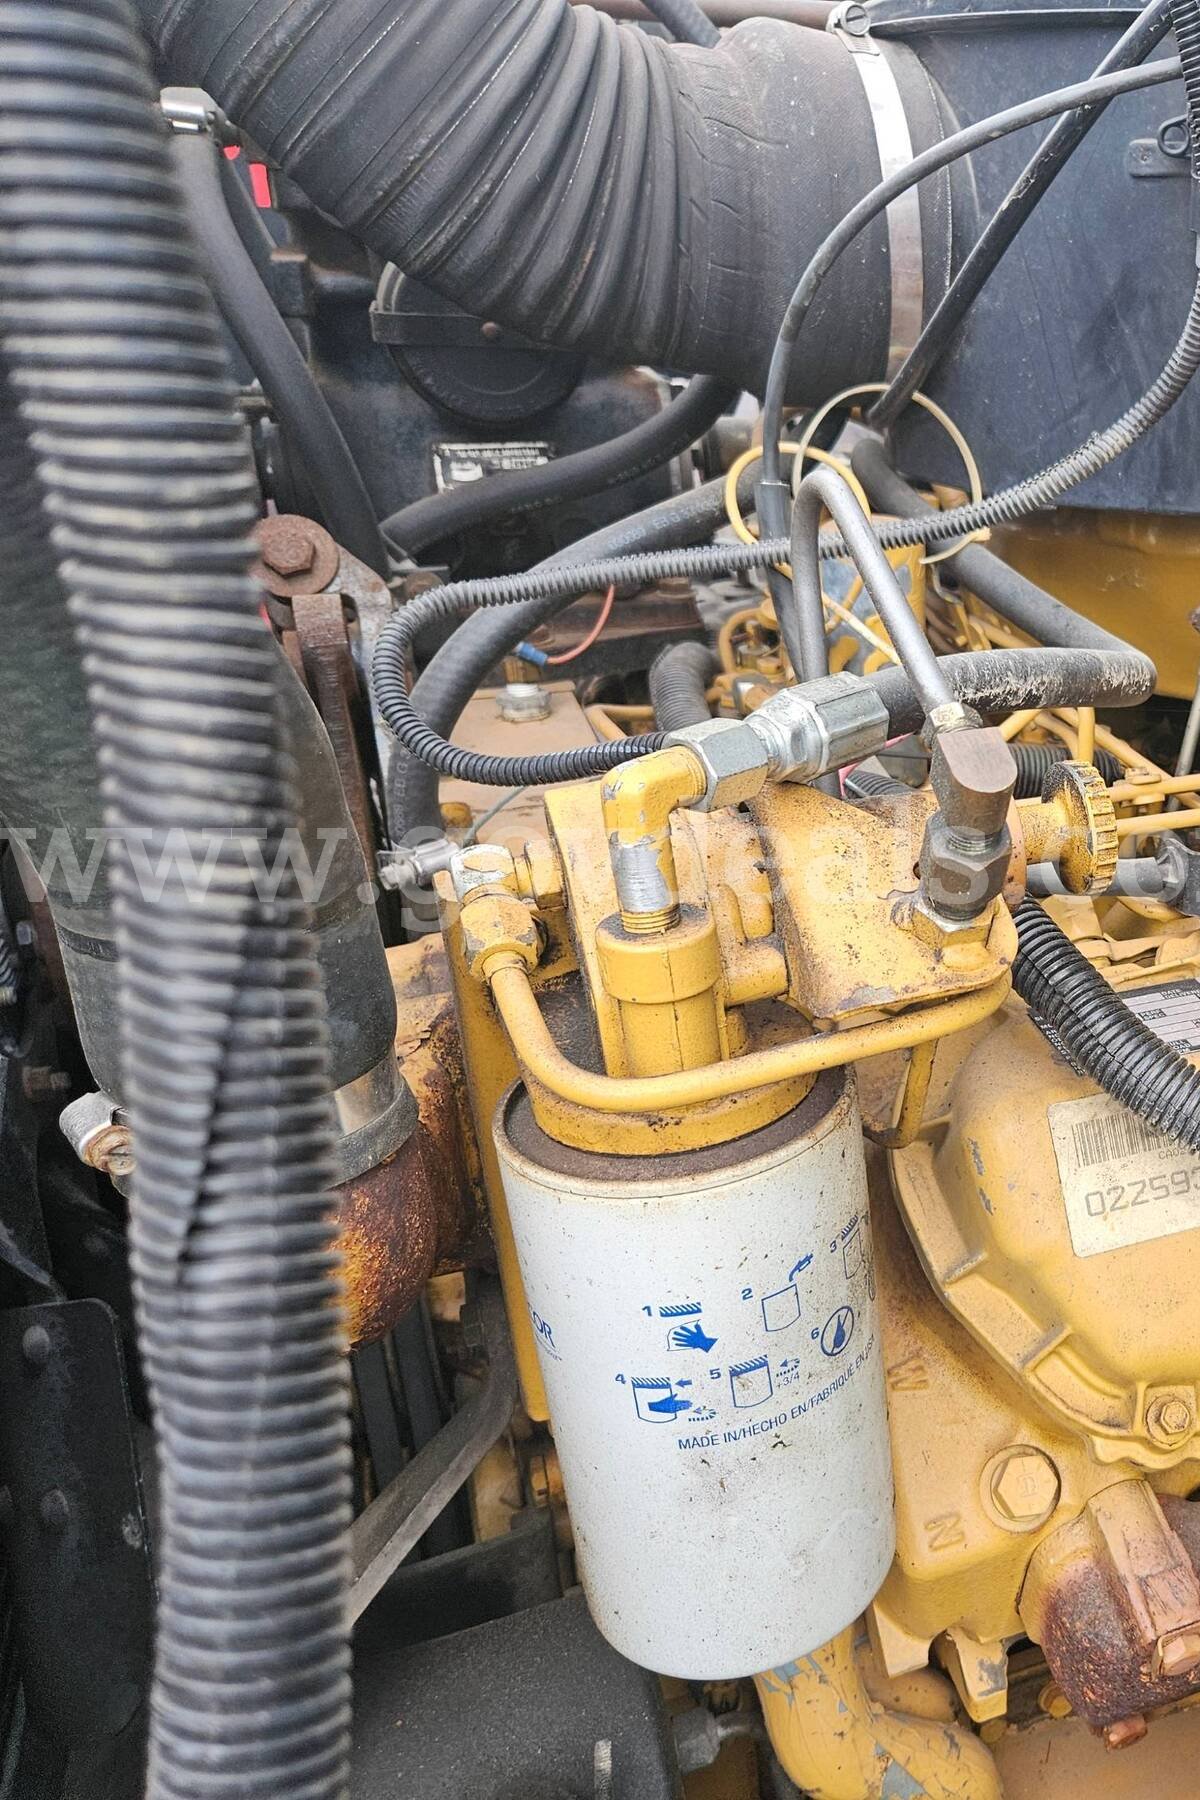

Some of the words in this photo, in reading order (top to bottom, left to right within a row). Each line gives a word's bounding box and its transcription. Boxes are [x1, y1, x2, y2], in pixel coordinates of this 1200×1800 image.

[741, 1287, 754, 1301] 2
[641, 1305, 653, 1317] 1
[810, 1326, 820, 1340] 6
[614, 1373, 627, 1385] 4
[709, 1368, 722, 1381] 5
[678, 1434, 721, 1450] MADE
[723, 1412, 788, 1444] IN/HECHO
